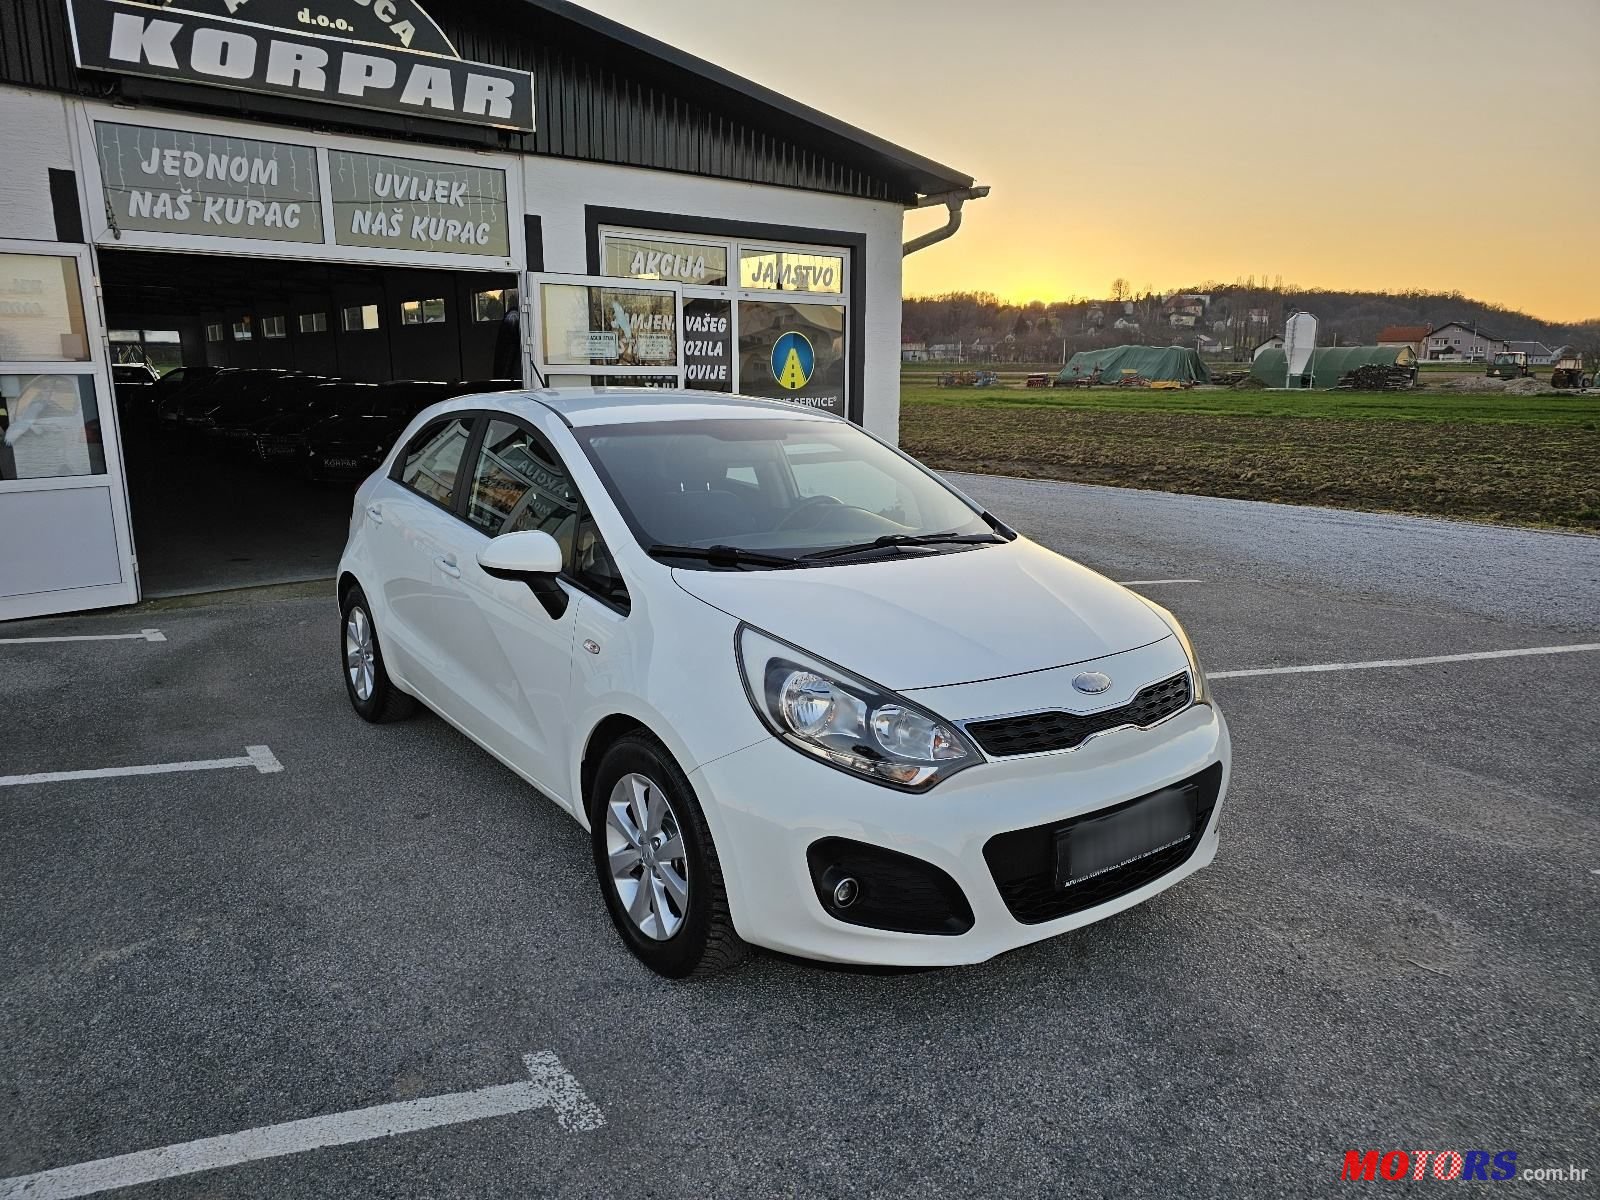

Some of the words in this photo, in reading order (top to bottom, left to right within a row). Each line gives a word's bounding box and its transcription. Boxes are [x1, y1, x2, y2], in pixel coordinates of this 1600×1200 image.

[297, 8, 354, 32] d.o.o.
[109, 12, 516, 119] KORPAR
[141, 147, 278, 186] JEDNOM
[374, 172, 467, 208] UVIJEK
[128, 188, 193, 221] NAŠ
[203, 196, 301, 229] KUPAC
[351, 207, 404, 237] NAŠ
[411, 215, 491, 245] KUPAC
[630, 250, 705, 279] AKCIJA
[751, 261, 834, 287] JAMSTVO
[685, 312, 727, 333] VAŠEG
